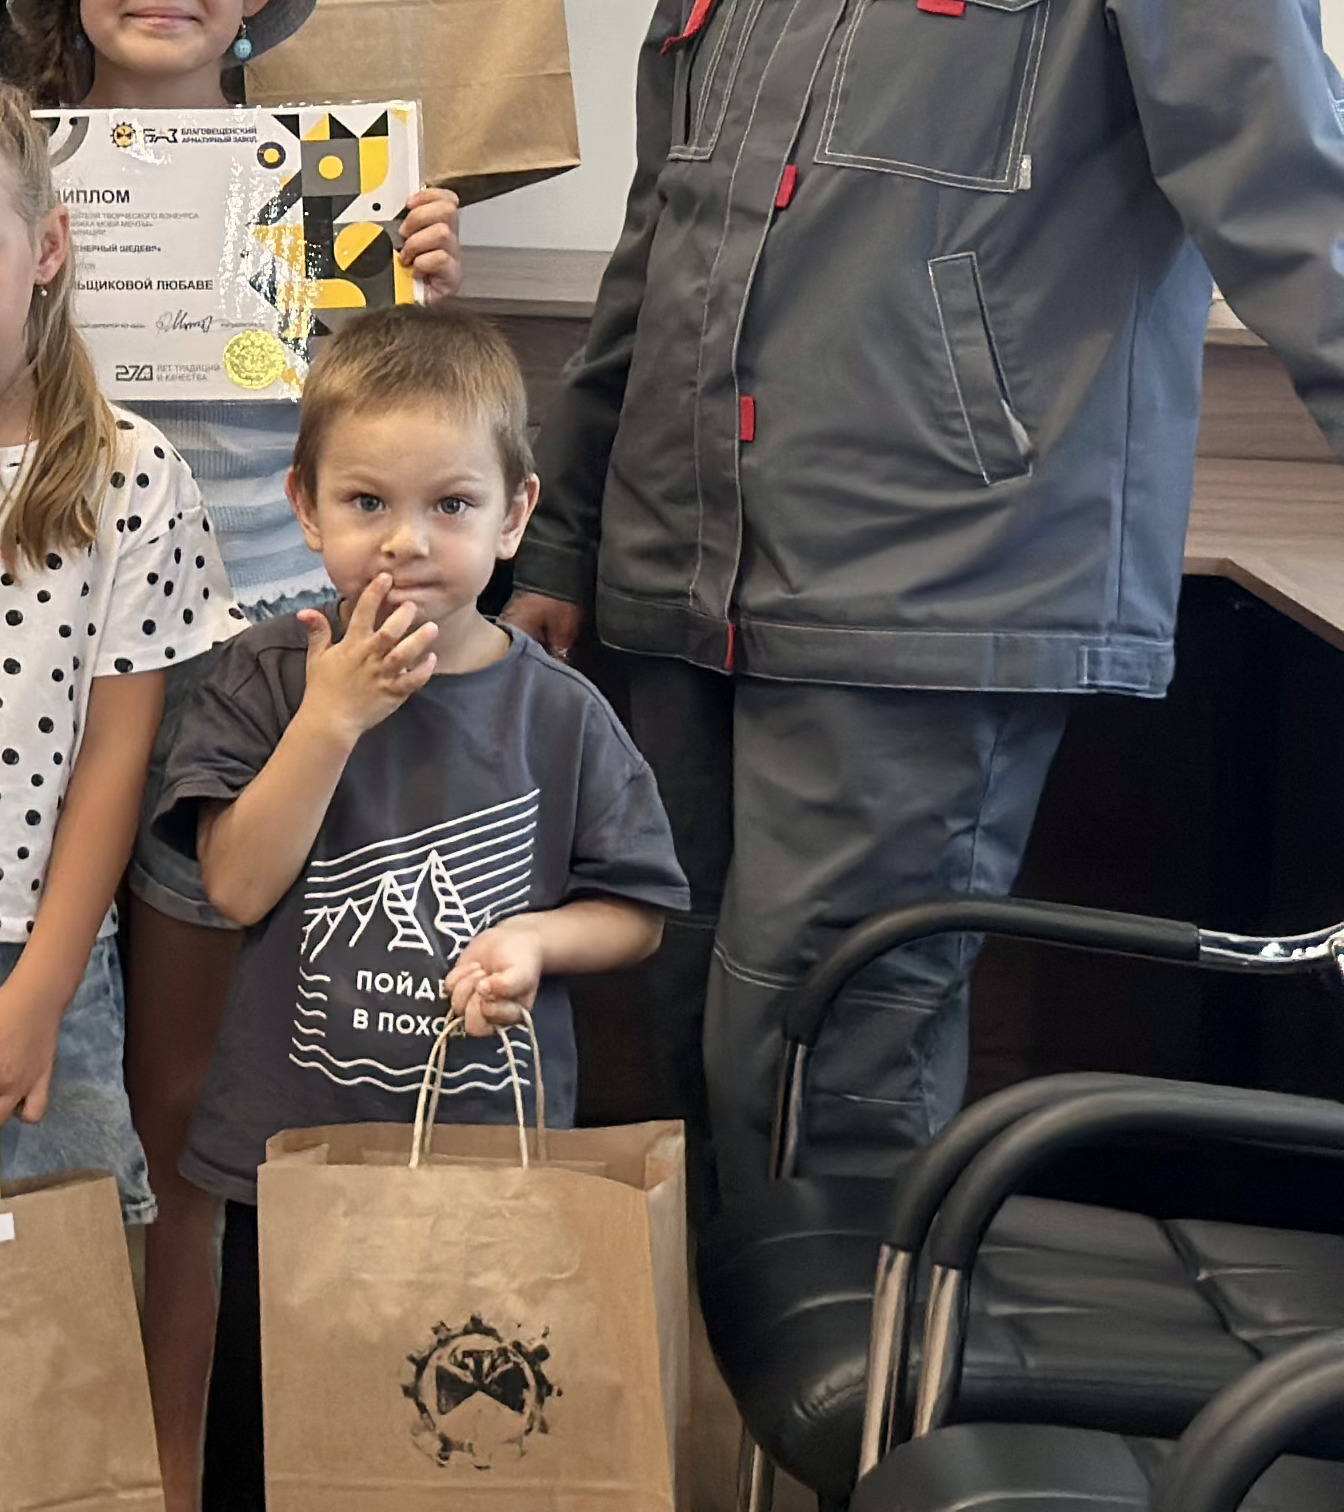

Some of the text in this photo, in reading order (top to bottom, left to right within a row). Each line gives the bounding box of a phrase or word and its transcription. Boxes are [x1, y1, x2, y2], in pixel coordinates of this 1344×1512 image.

[77, 277, 214, 292] ЬЩИКОВОЙ ЛЮБАВЕ
[352, 1008, 370, 1030] В
